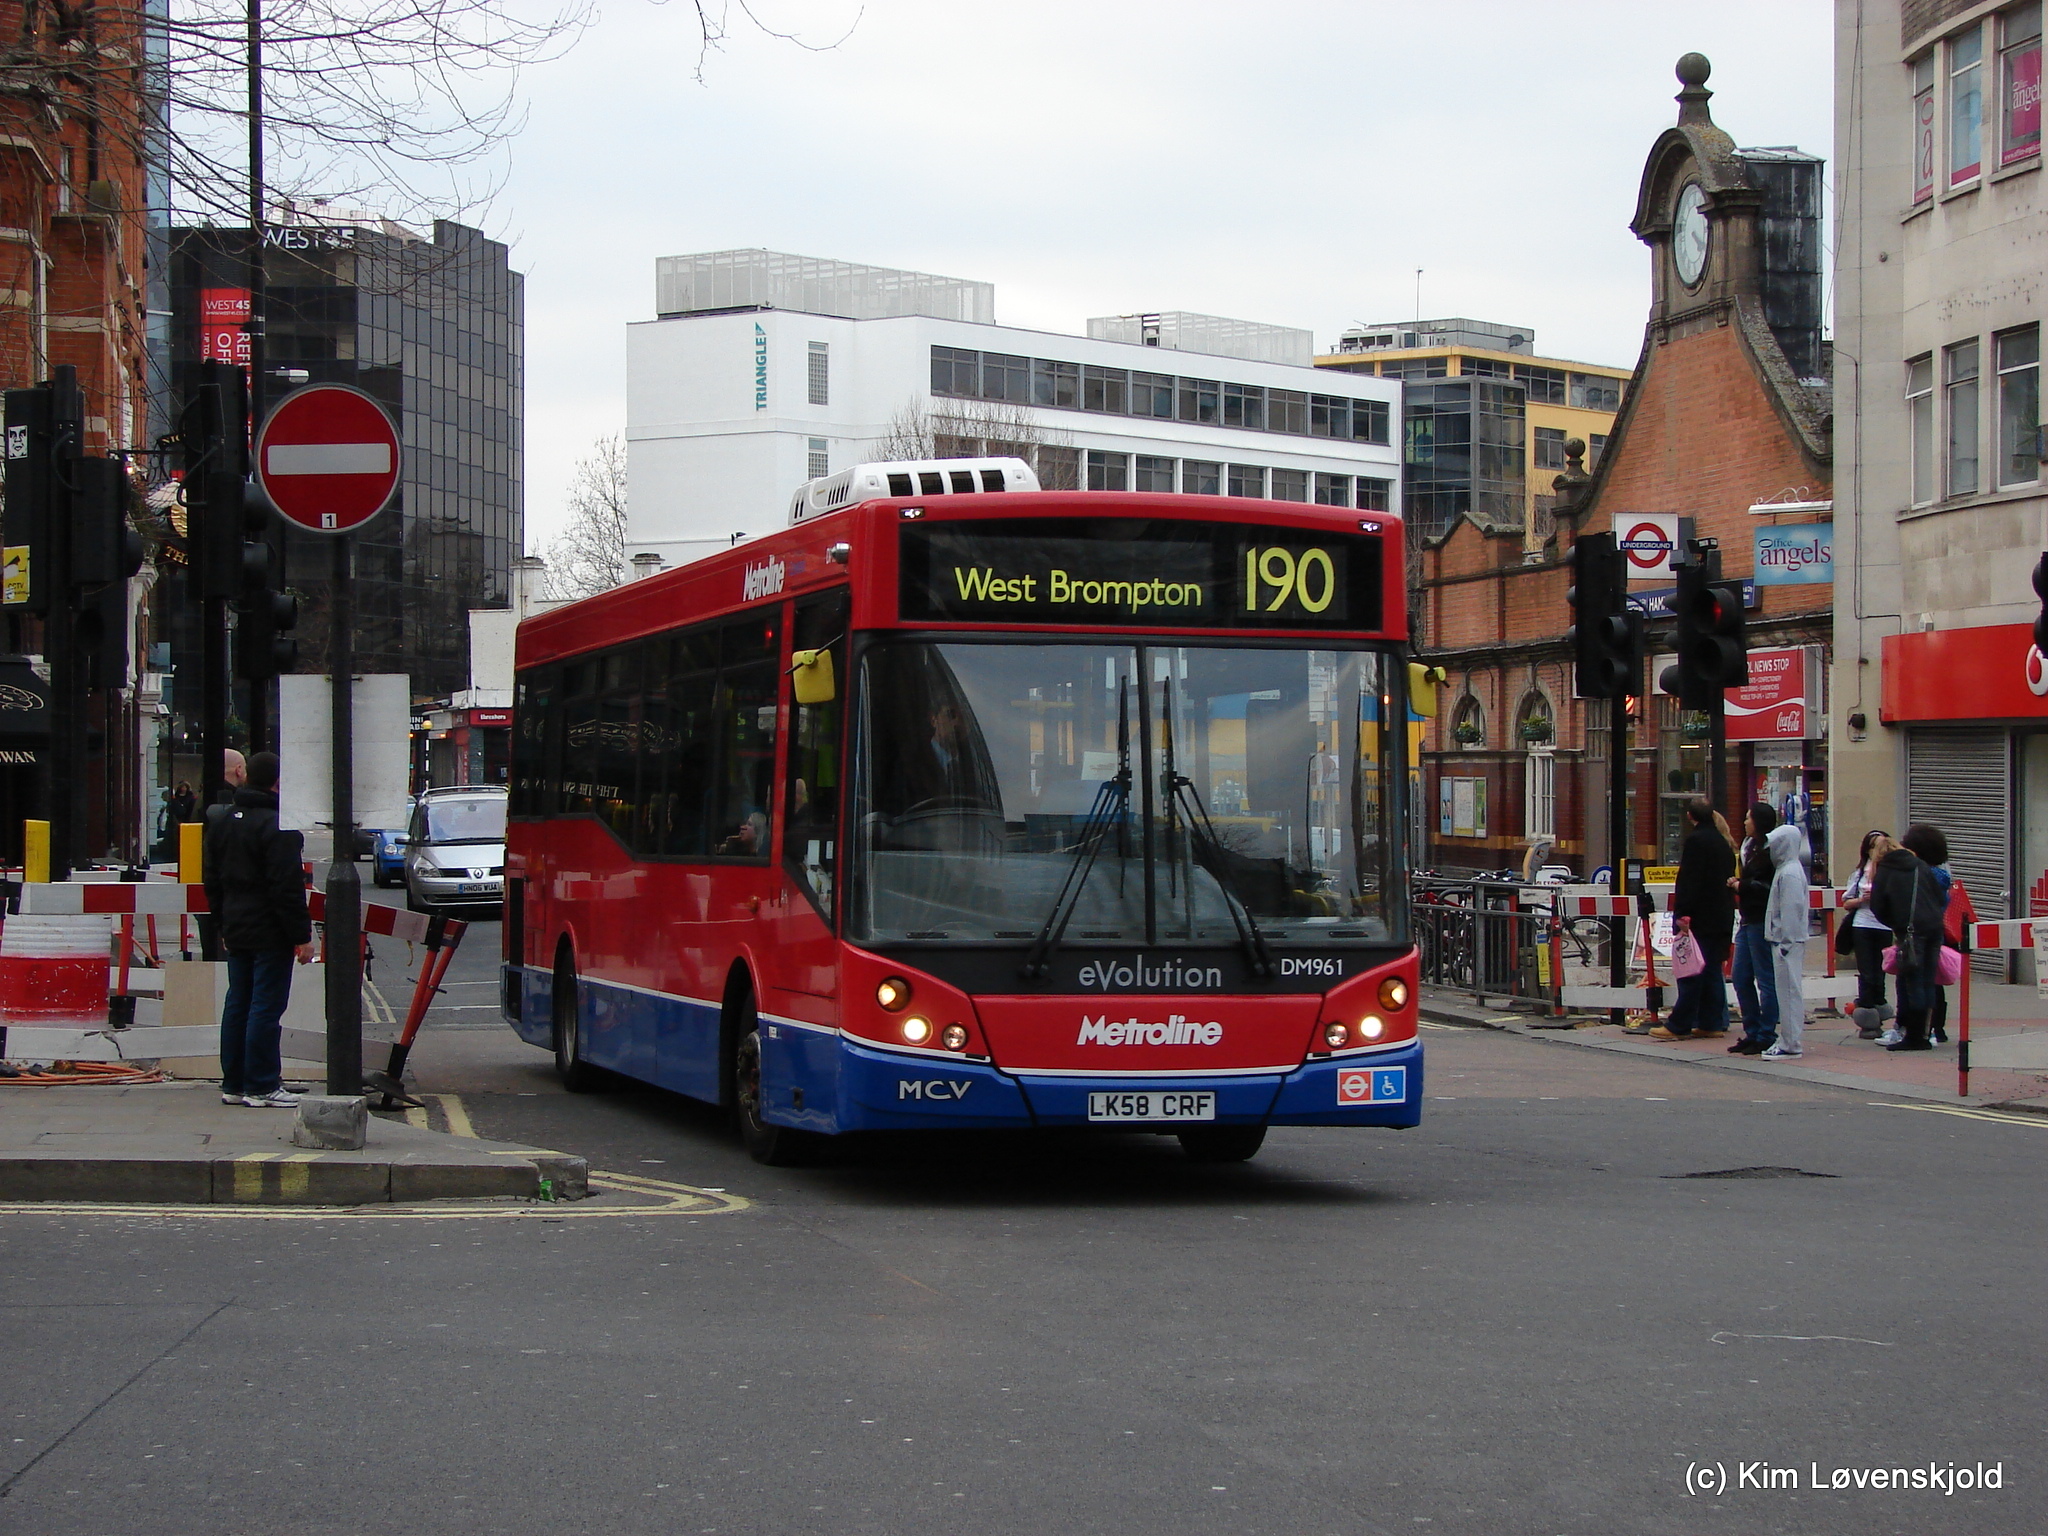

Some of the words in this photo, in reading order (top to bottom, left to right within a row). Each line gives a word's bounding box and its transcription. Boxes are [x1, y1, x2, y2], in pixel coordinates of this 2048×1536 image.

[2012, 75, 2041, 111] angel
[205, 300, 250, 310] WEST45
[755, 336, 767, 411] TRIANGLE
[326, 514, 333, 527] 1
[1622, 541, 1671, 550] UNDERGROUND
[1758, 537, 1793, 549] Office
[1760, 538, 1832, 572] angels
[742, 554, 786, 602] Metroline
[953, 566, 1037, 603] West
[1049, 568, 1203, 615] Brompton
[1245, 545, 1336, 613] 190
[1754, 659, 1773, 672] NEWS
[1773, 658, 1790, 671] STOP
[1078, 957, 1223, 991] eVolution
[1280, 958, 1344, 977] DM961
[1076, 1015, 1223, 1046] Metroline
[898, 1080, 973, 1101] MCV
[1090, 1094, 1150, 1117] LK58
[1162, 1093, 1211, 1116] CRF
